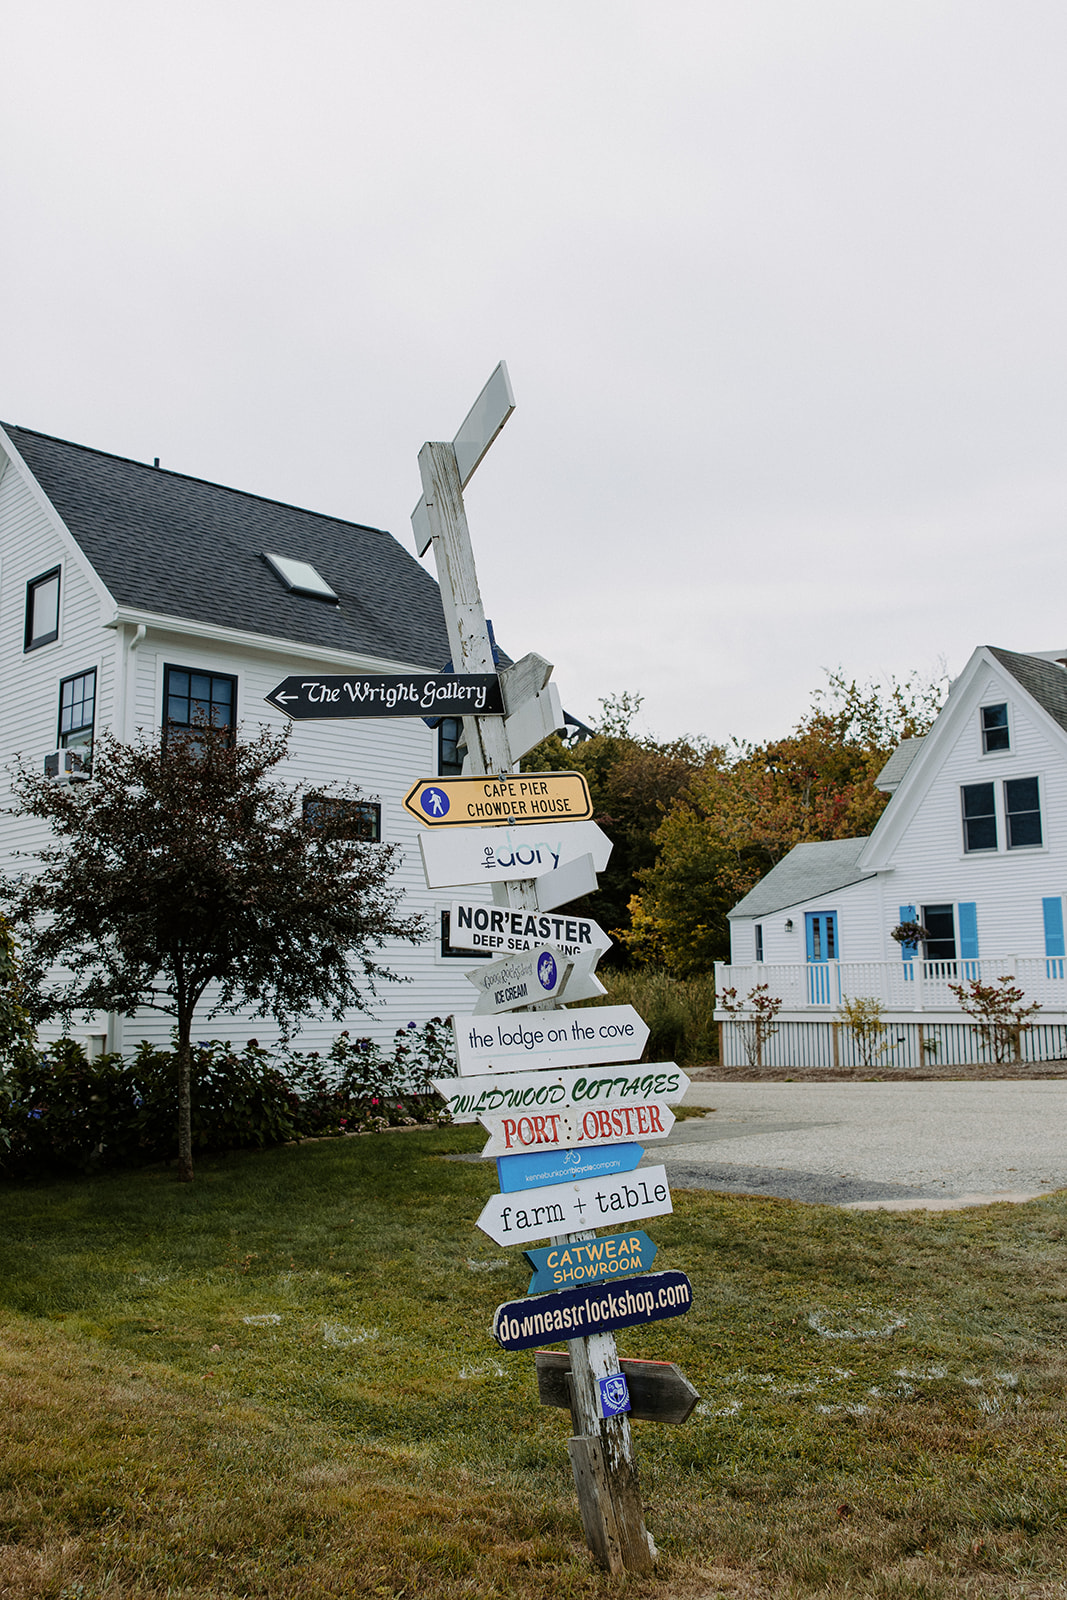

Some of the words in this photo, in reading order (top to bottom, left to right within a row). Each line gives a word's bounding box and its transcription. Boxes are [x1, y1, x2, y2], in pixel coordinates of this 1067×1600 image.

[301, 682, 340, 703] The
[343, 681, 419, 708] Wright
[420, 681, 487, 708] Gallery
[484, 783, 516, 797] CAPE
[520, 782, 548, 796] PIER
[467, 801, 527, 817] CHOWDER
[530, 798, 572, 813] HOUSE
[481, 846, 496, 869] the
[495, 830, 562, 870] dory
[457, 905, 592, 944] NOR'EASTER
[473, 933, 504, 948] DEEP
[507, 938, 530, 951] SEA
[494, 988, 505, 1005] ICE
[504, 983, 528, 1002] CREAM
[469, 1028, 494, 1049] the
[497, 1024, 544, 1050] lodge
[547, 1028, 568, 1042] on
[571, 1020, 595, 1040] the
[598, 1022, 634, 1038] cove
[450, 1085, 566, 1114] WILDWOOD
[571, 1073, 680, 1101] COTTAGES
[502, 1114, 561, 1149] PORT
[577, 1105, 665, 1142] OBSTER
[500, 1203, 566, 1232] farm
[595, 1182, 667, 1213] table
[547, 1237, 642, 1268] CATWEAR
[553, 1255, 643, 1284] SHOWROOM
